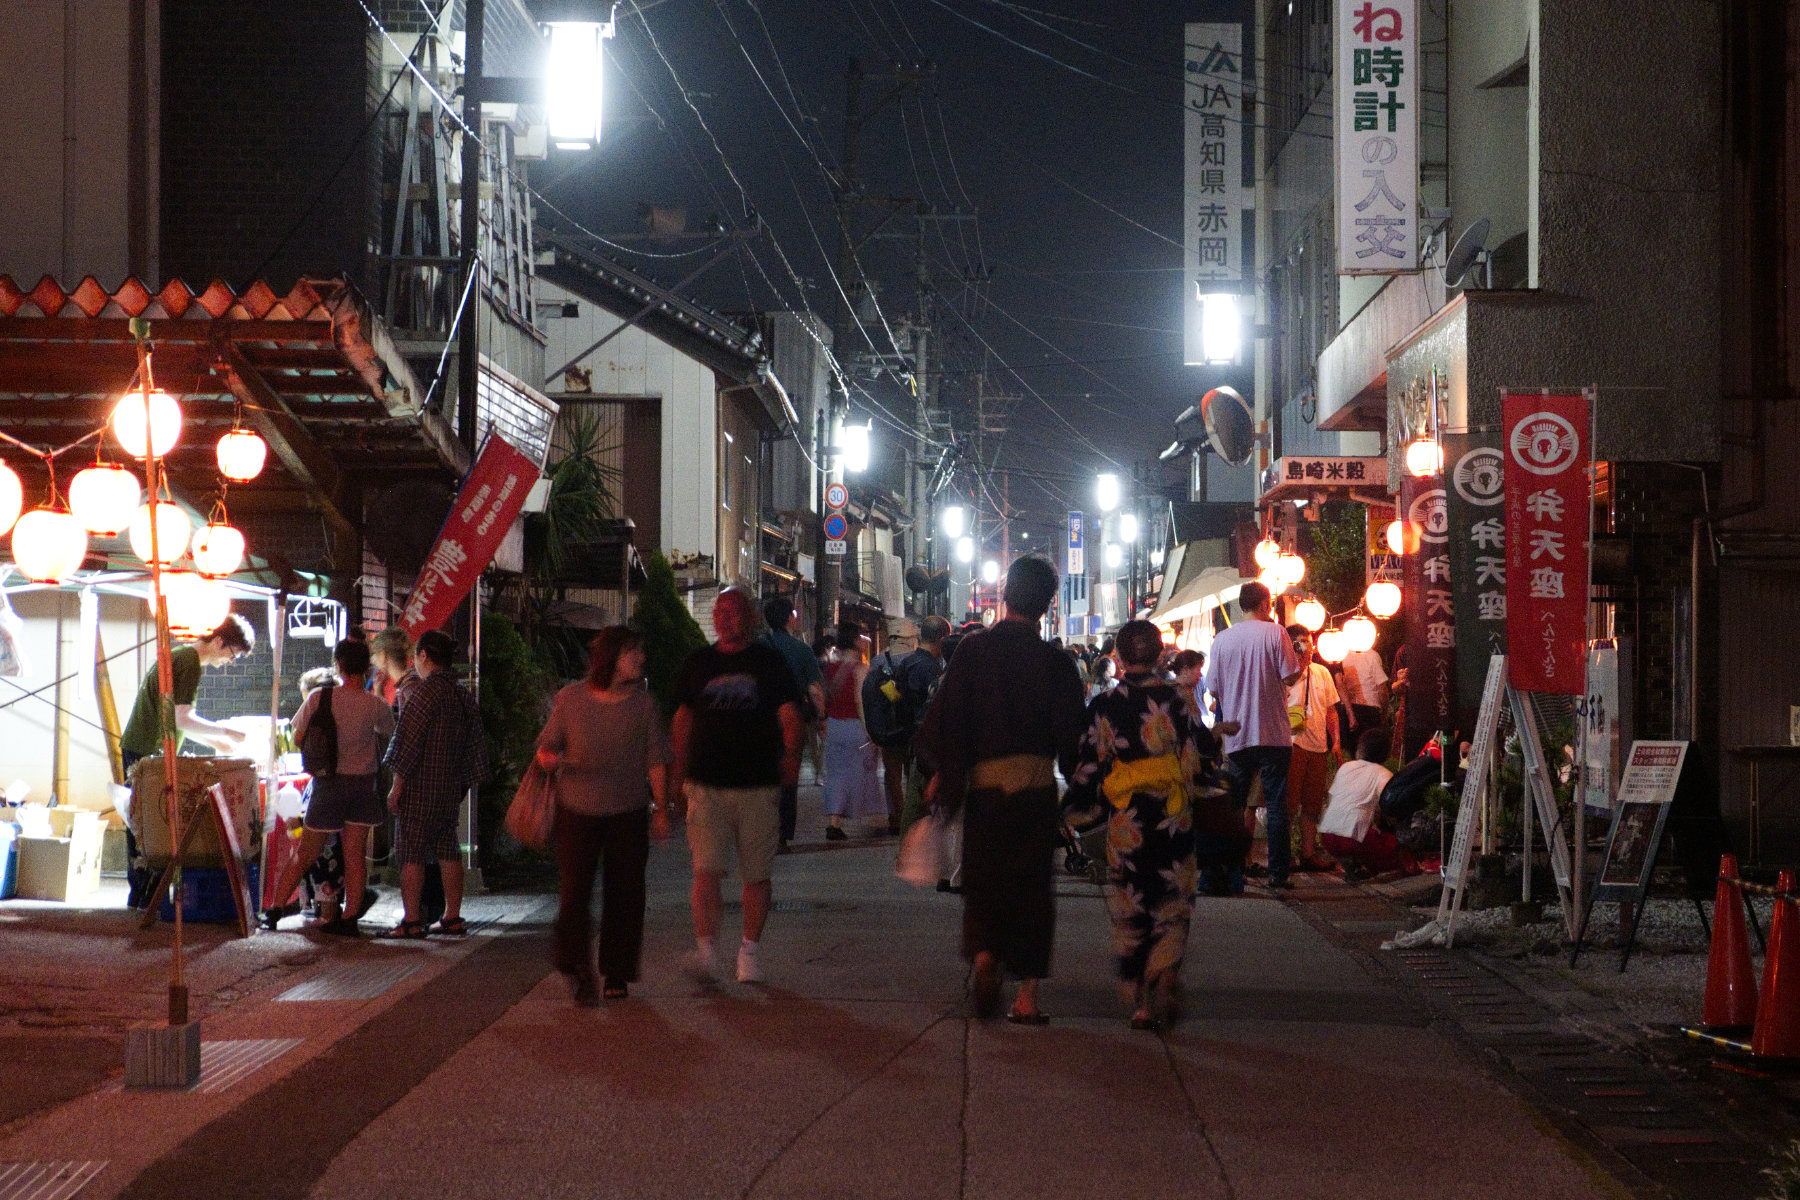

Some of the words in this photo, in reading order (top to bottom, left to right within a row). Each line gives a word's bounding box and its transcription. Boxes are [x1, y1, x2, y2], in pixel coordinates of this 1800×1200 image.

[1286, 460, 1366, 480] 島崎米穀
[830, 490, 843, 502] 30
